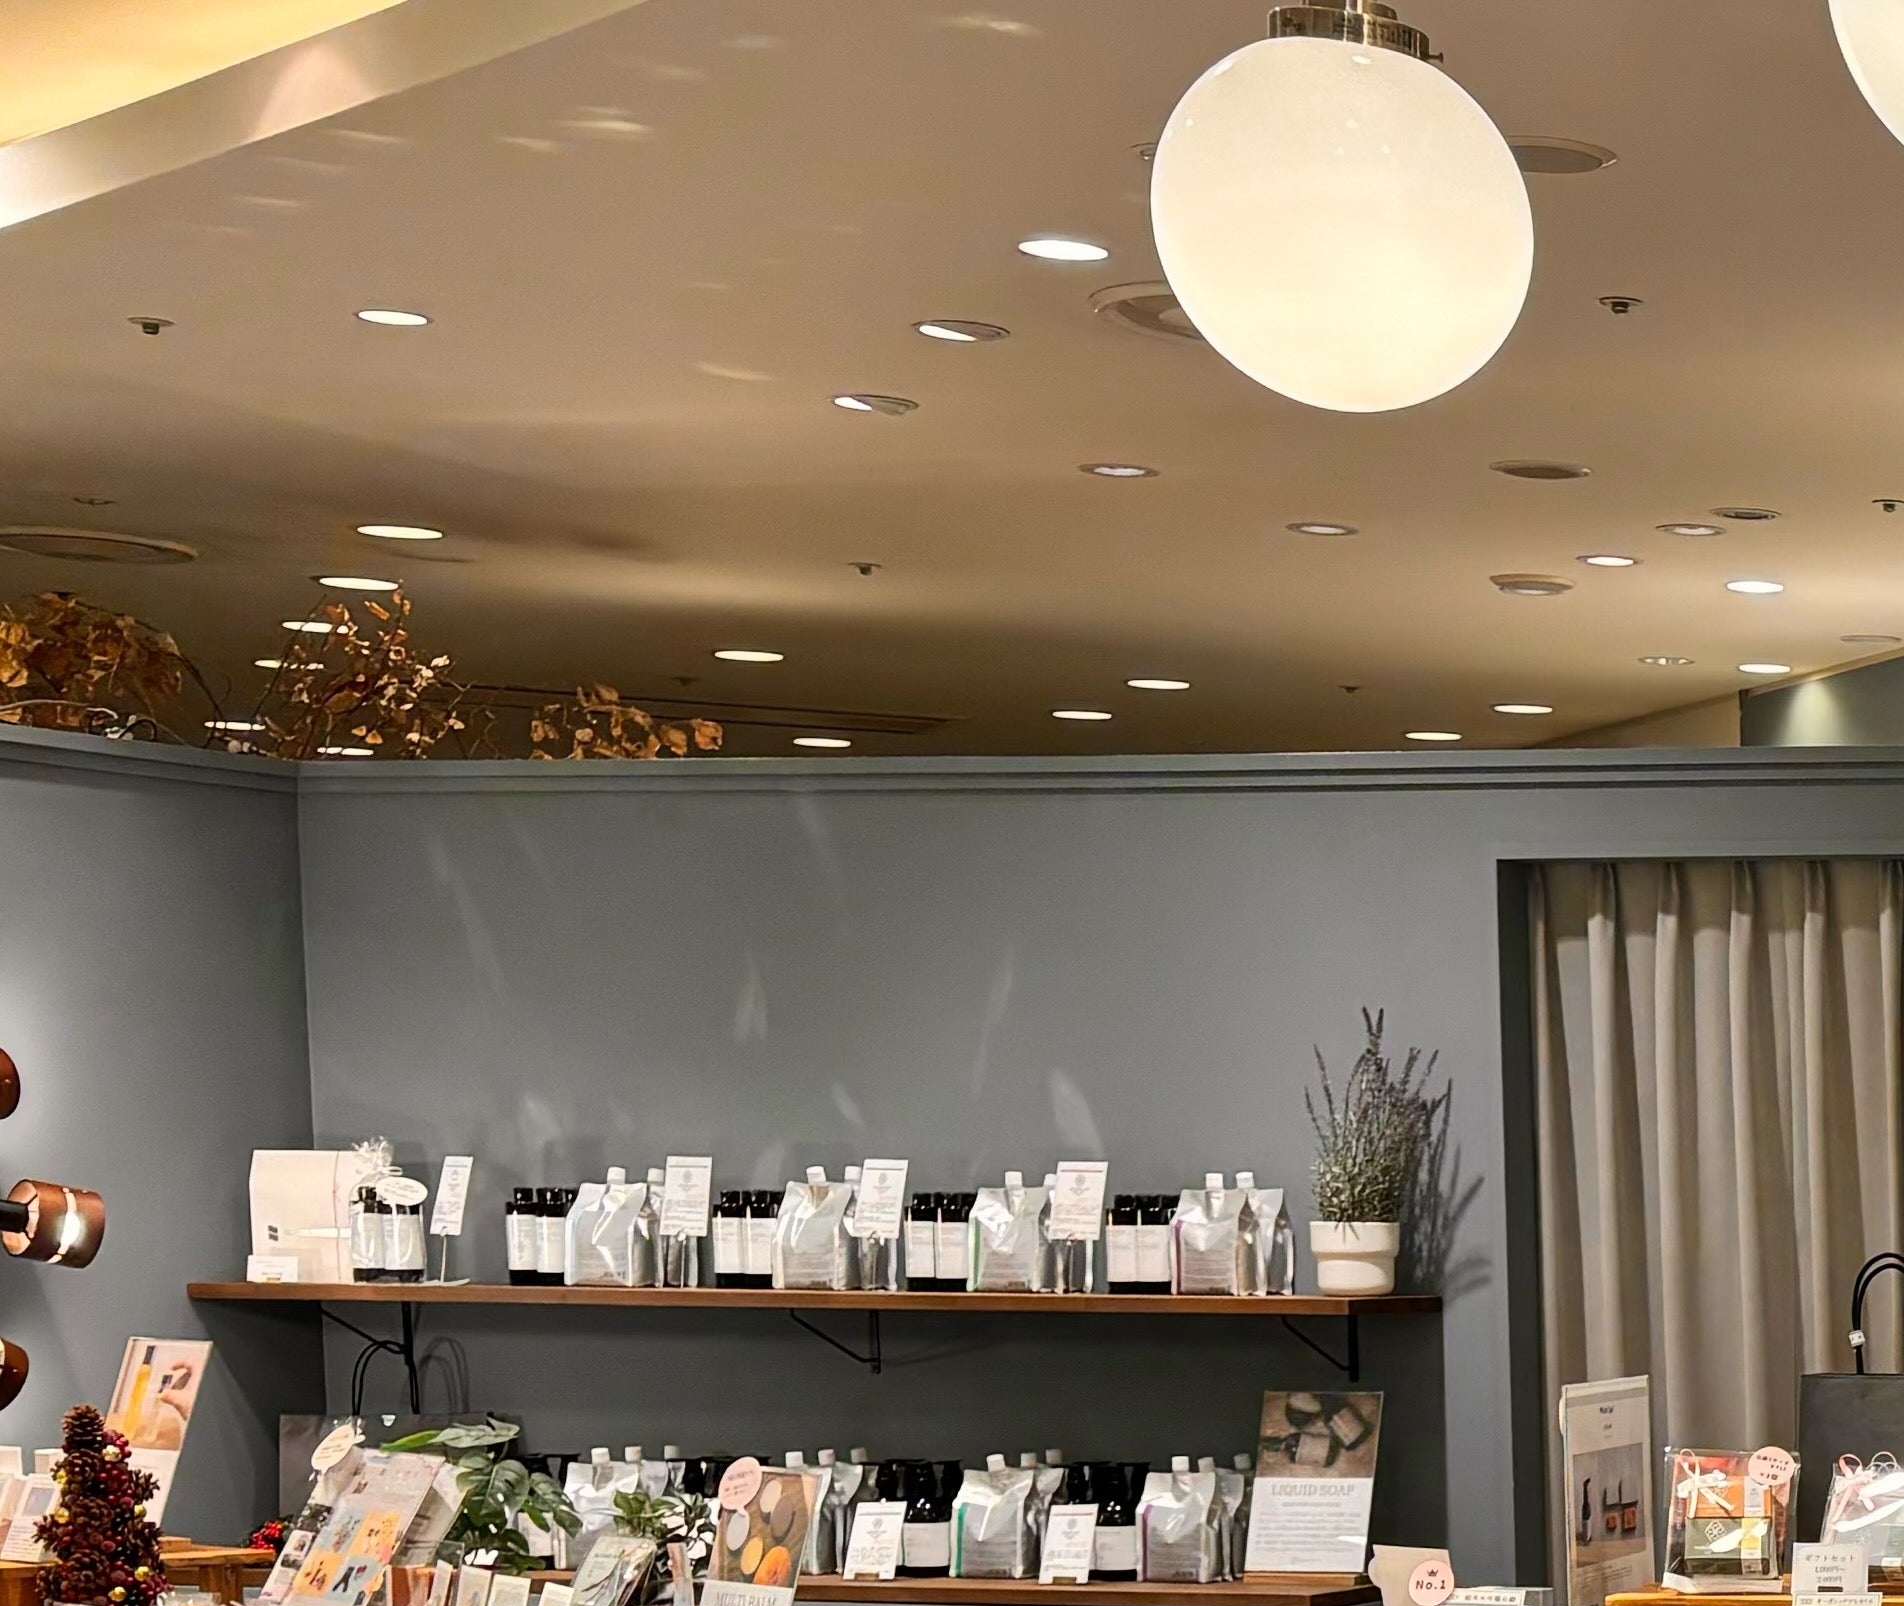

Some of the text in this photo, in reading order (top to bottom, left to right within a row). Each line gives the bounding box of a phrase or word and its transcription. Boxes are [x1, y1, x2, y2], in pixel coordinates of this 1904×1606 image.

[1272, 1484, 1356, 1496] LIQUID SOAP
[1415, 1580, 1446, 1590] No.1
